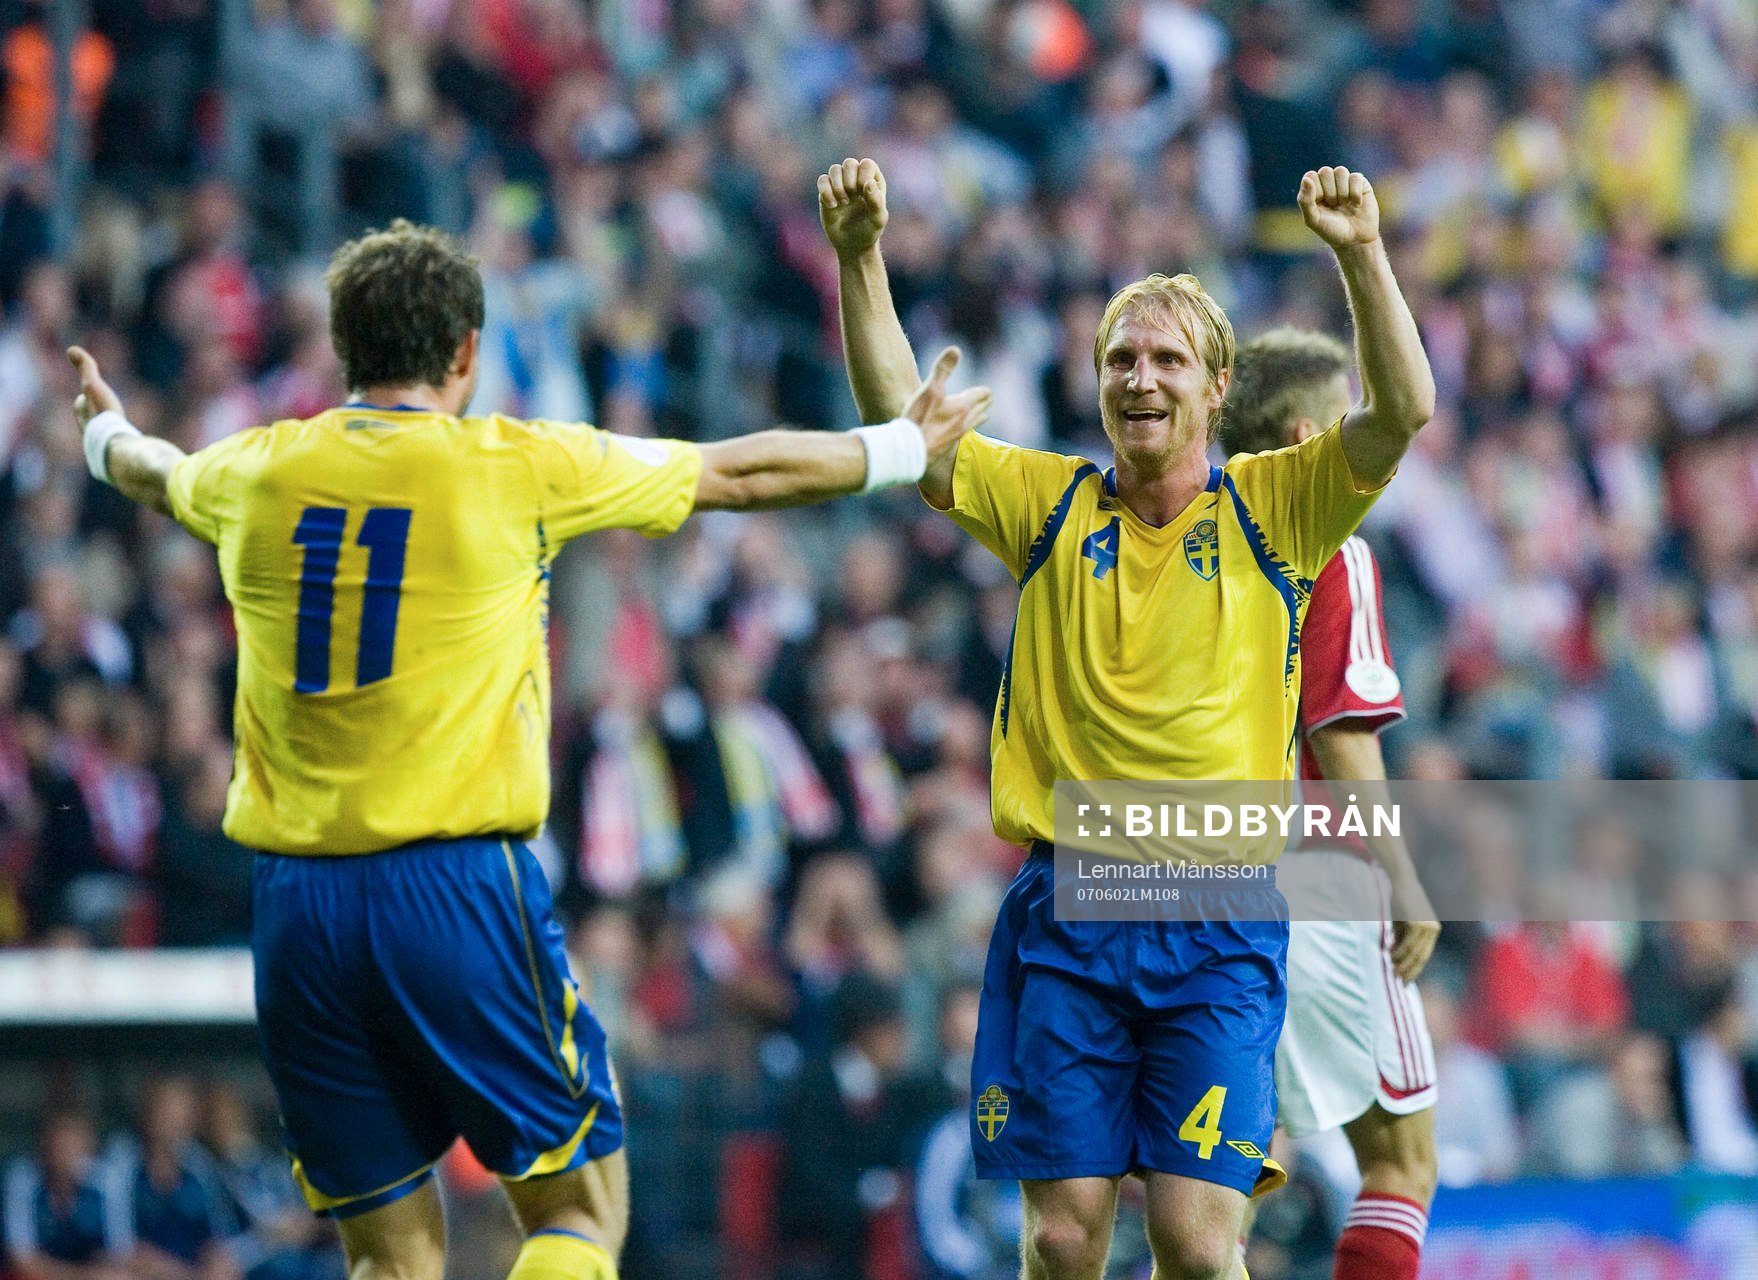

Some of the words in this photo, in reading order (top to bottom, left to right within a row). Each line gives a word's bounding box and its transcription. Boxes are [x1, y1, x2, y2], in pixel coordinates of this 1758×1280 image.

[1081, 516, 1120, 580] 4
[292, 507, 412, 694] 11
[1178, 1085, 1228, 1160] 4
